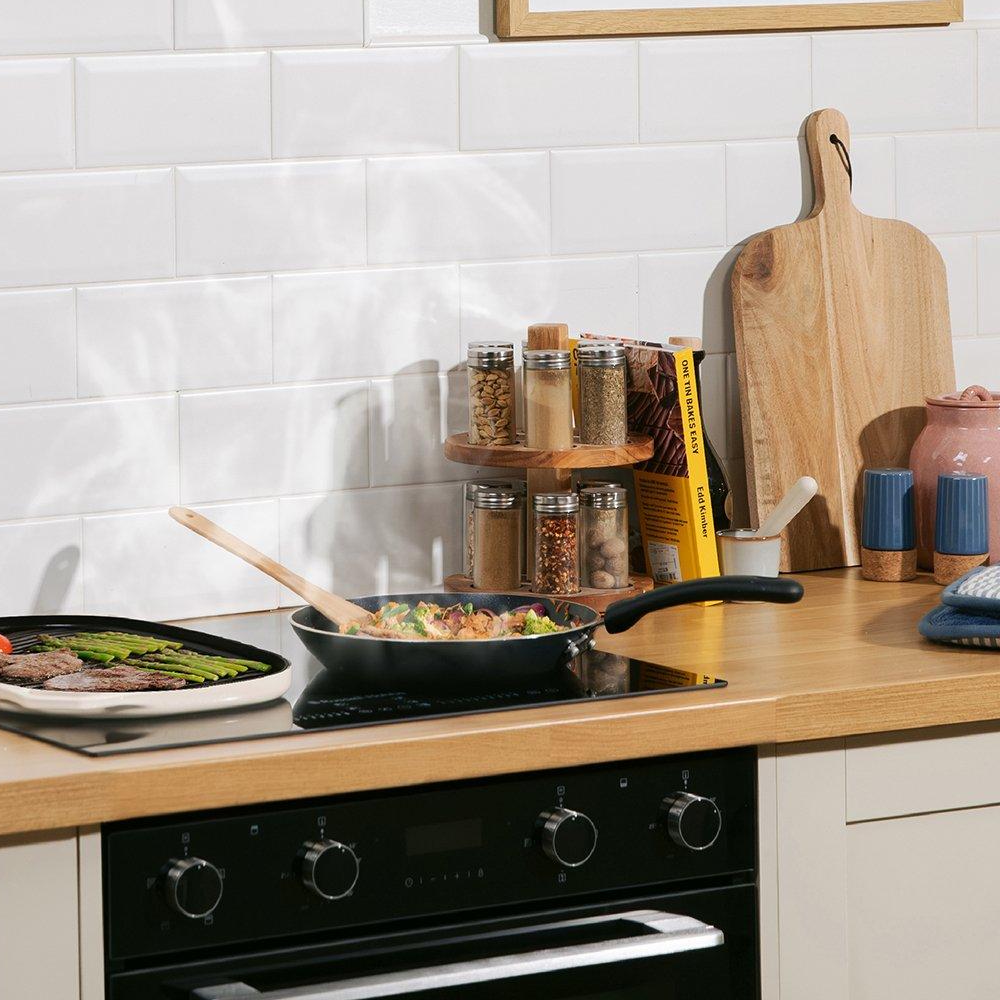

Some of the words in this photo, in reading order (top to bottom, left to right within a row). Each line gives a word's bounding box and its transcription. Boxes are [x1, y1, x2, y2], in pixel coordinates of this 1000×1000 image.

[682, 360, 690, 379] ONE
[684, 381, 692, 397] TIN
[686, 398, 696, 429] BAKES
[690, 431, 699, 454] EASY
[697, 486, 706, 504] Edd
[699, 505, 708, 538] Kimber
